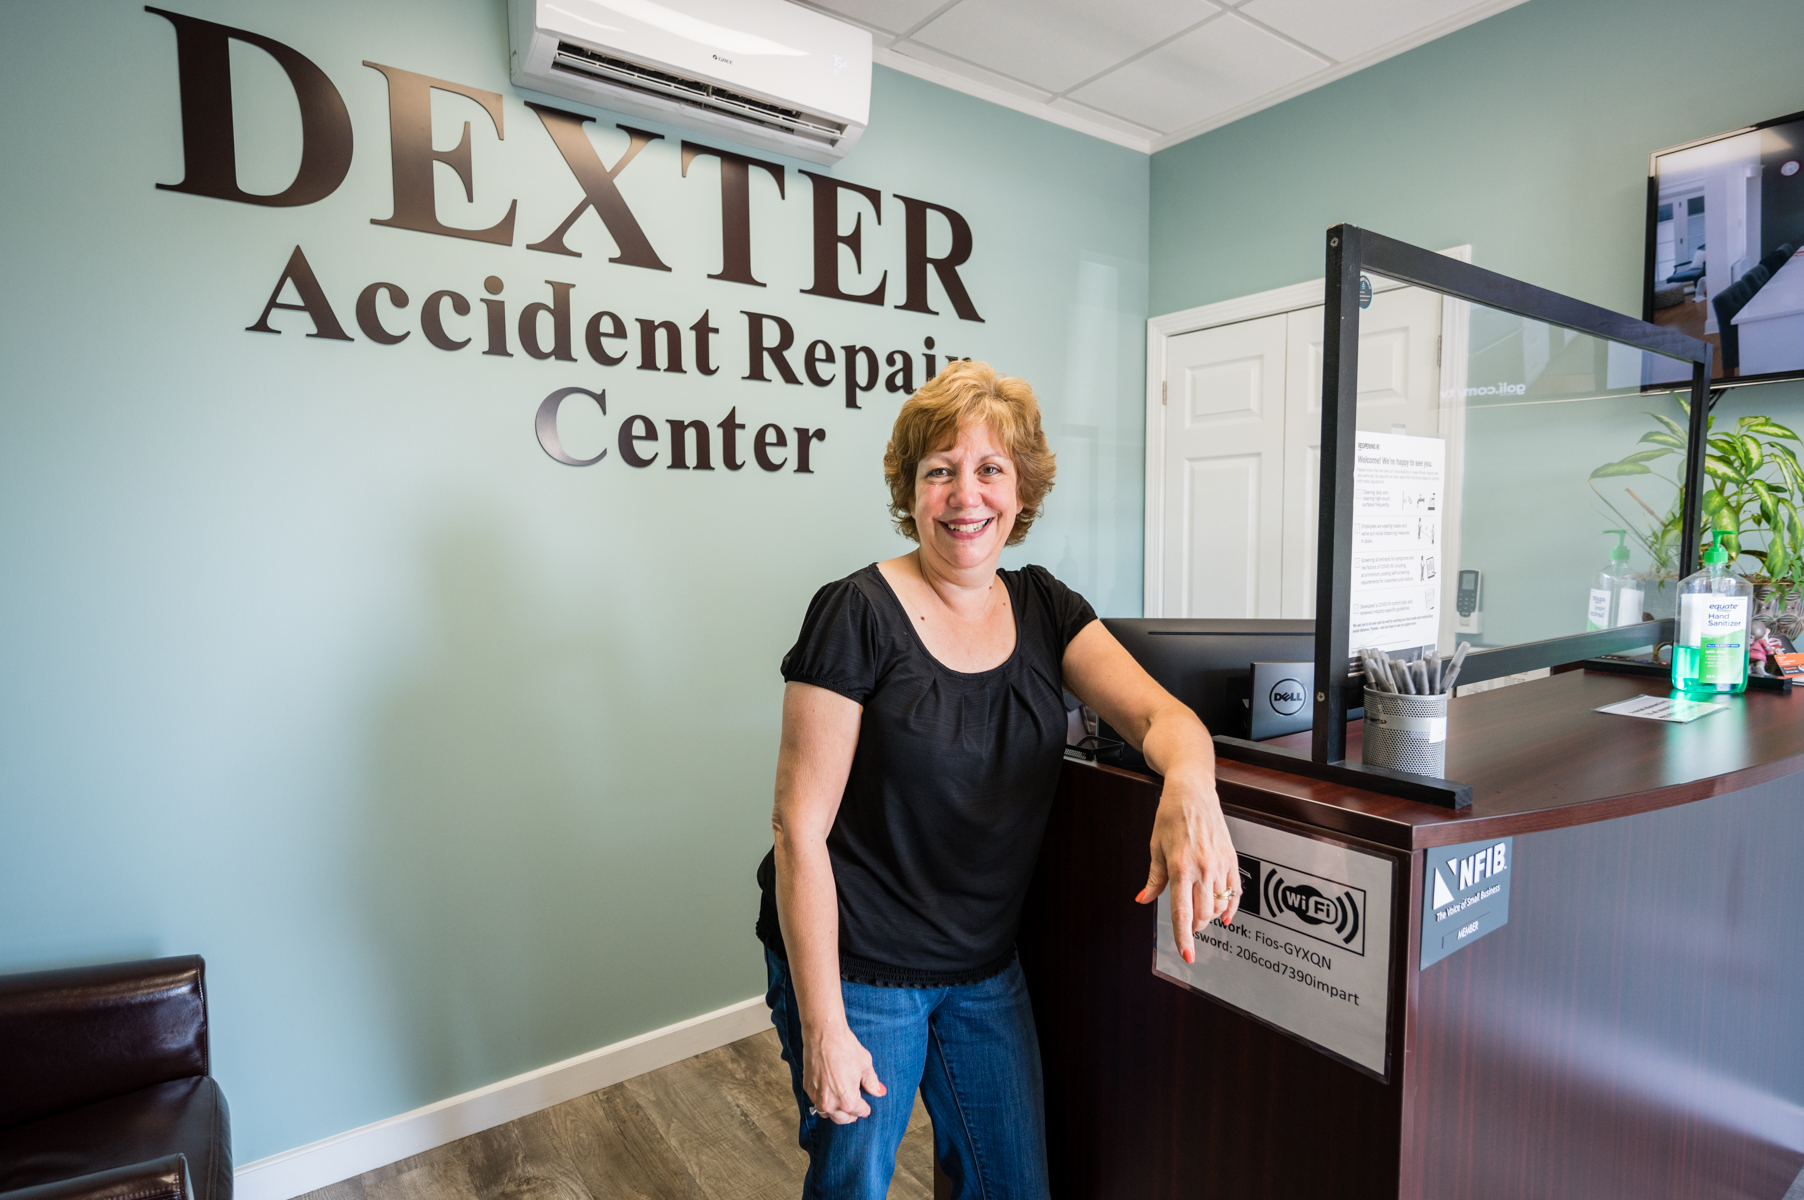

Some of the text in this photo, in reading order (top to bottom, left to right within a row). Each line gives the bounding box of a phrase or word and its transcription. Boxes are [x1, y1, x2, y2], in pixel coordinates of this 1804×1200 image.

[144, 5, 985, 323] DEXTER
[245, 244, 973, 410] Accident Repai
[535, 386, 826, 474] Center
[1357, 455, 1381, 464] Welcome!
[1382, 456, 1395, 465] We're
[1396, 458, 1409, 468] happy
[1709, 603, 1739, 612] equate
[1273, 692, 1303, 702] DELL
[1458, 842, 1506, 891] NFIB
[1436, 911, 1446, 922] The
[1446, 904, 1460, 917] Voice
[1466, 892, 1480, 907] Small
[1480, 884, 1500, 900] Business
[1209, 917, 1332, 970] twork: Fios-GYXQN
[1457, 920, 1479, 940] MEMBER
[1193, 931, 1360, 1006] sword: 206cod7390impart
